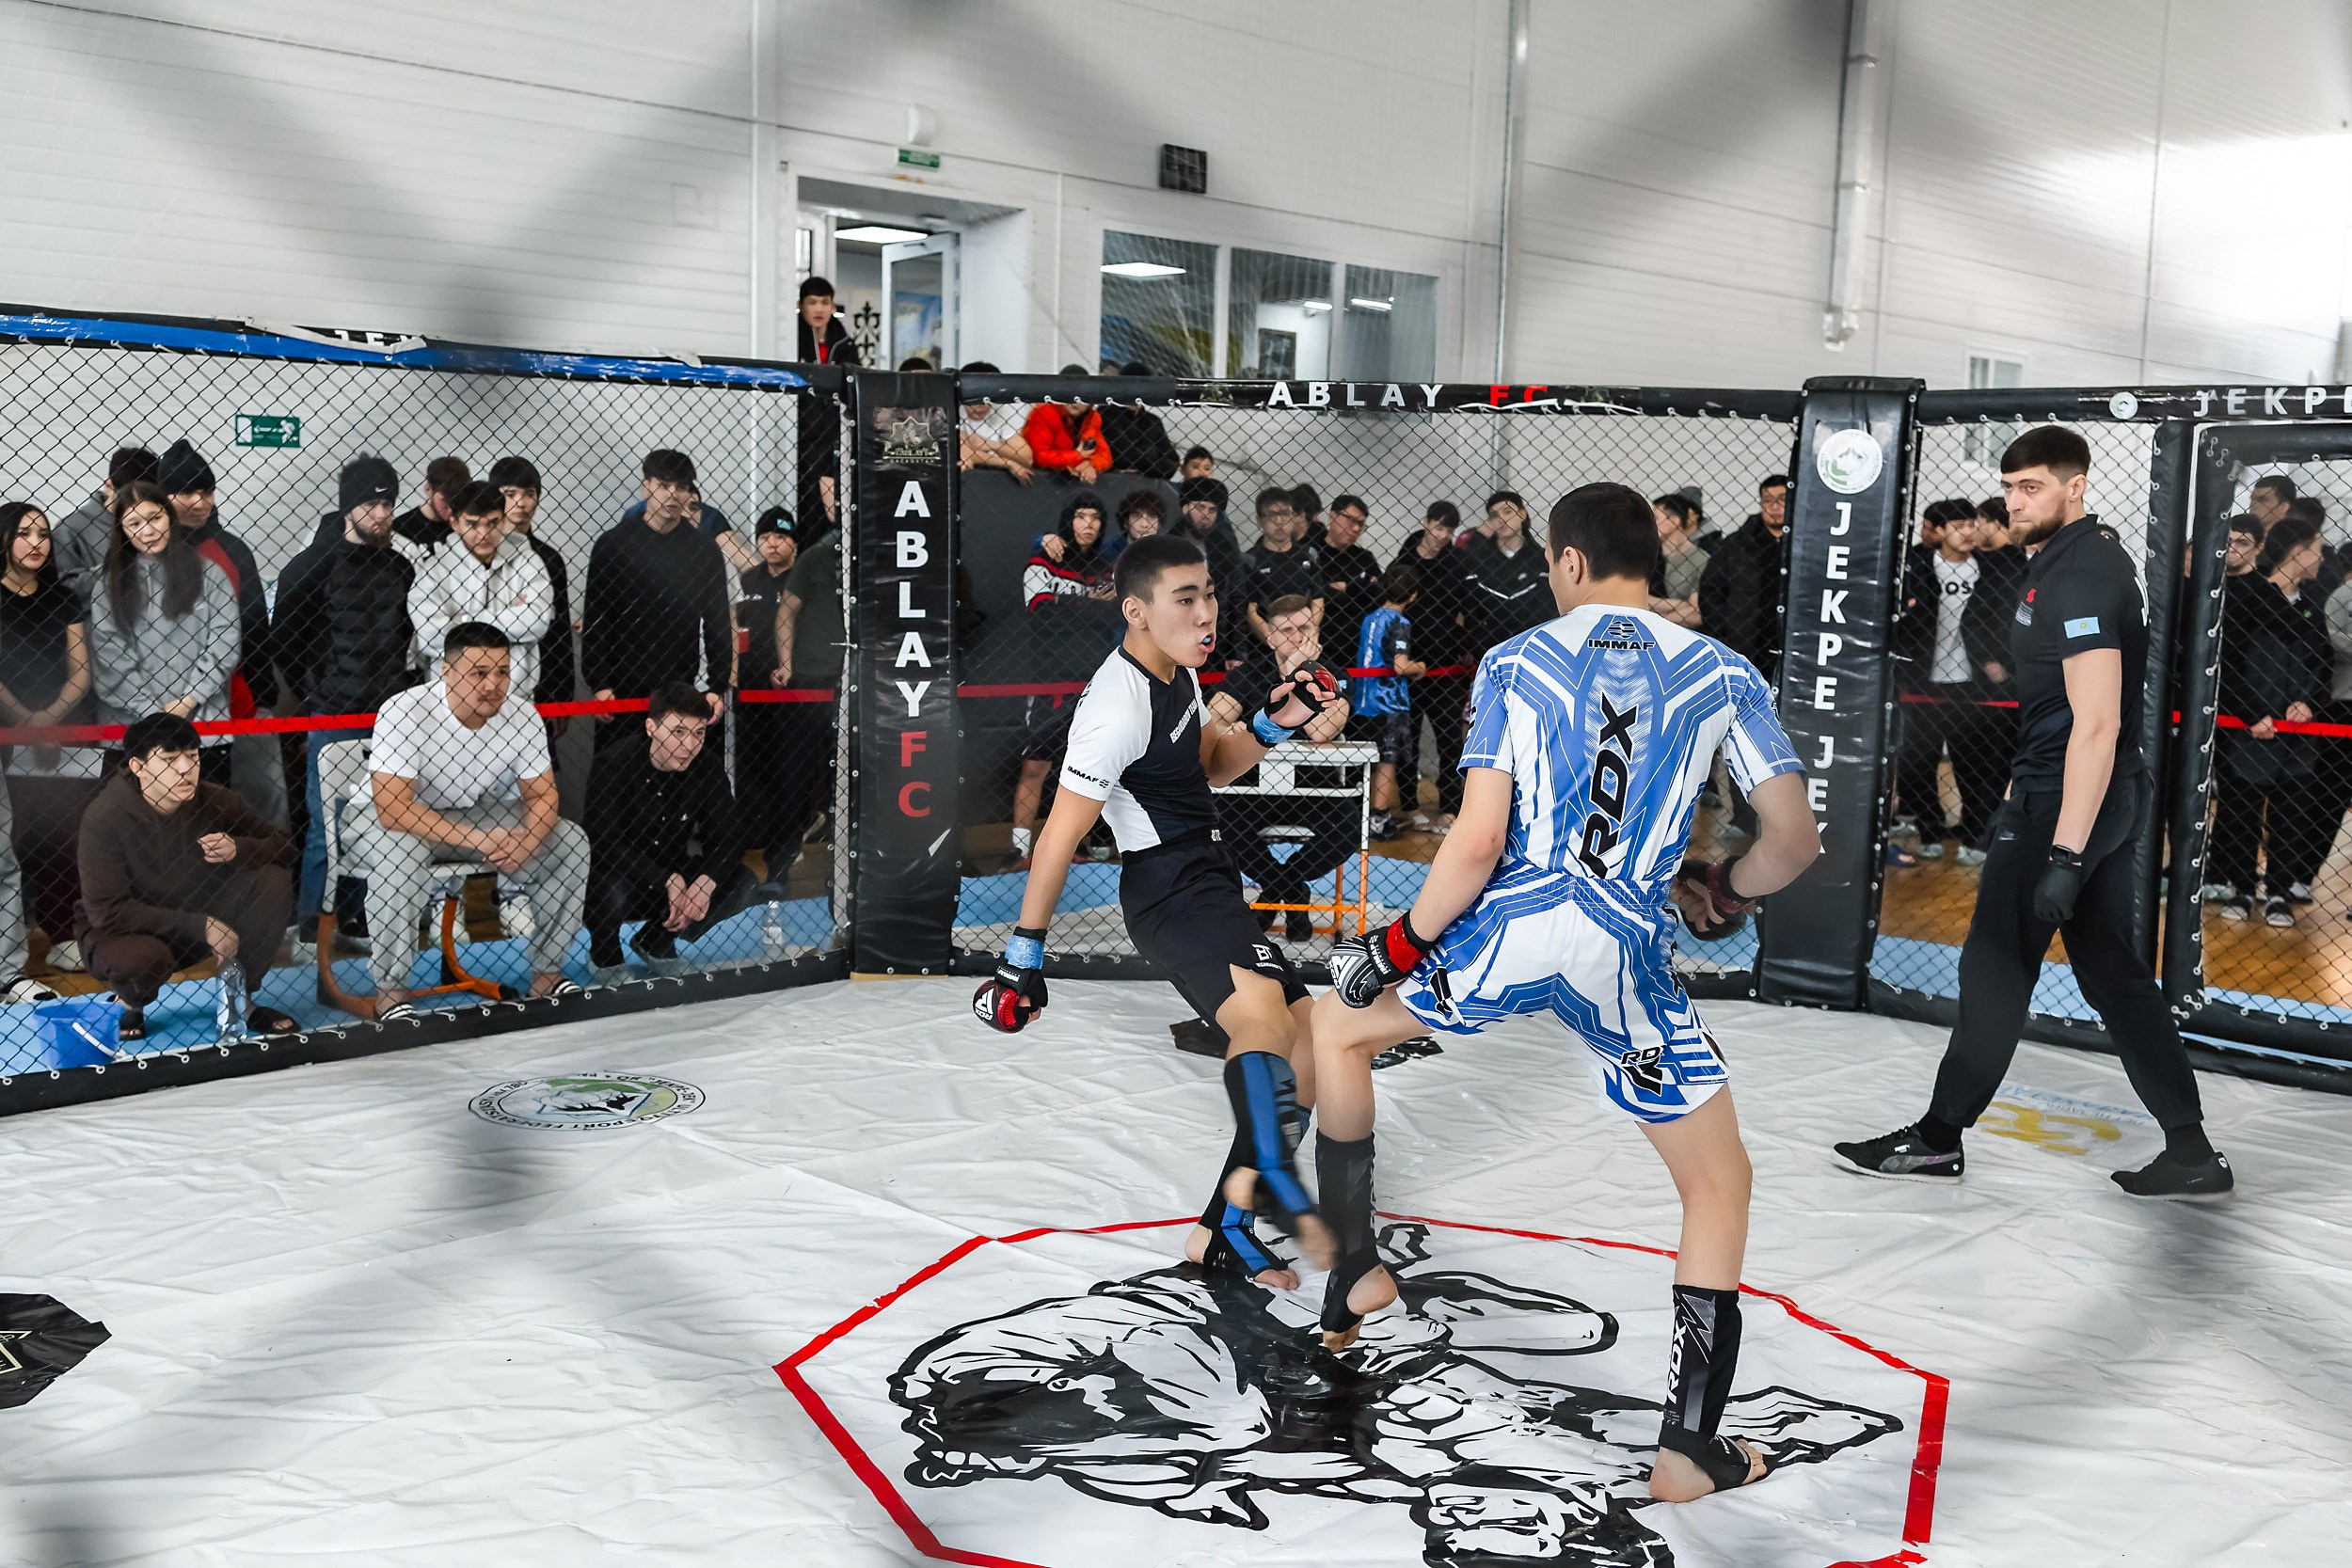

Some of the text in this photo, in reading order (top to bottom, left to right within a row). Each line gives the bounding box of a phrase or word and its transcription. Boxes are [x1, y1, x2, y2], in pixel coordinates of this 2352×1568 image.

[1268, 382, 1548, 407] ABLAY FC
[894, 481, 931, 718] ABLAY
[1814, 501, 1852, 711] JEKPE
[1588, 639, 1656, 651] IMMAF
[898, 731, 931, 817] FC
[1067, 765, 1099, 784] IMMAF
[1579, 689, 1639, 880] RDX
[1667, 1319, 1687, 1405] RDX
